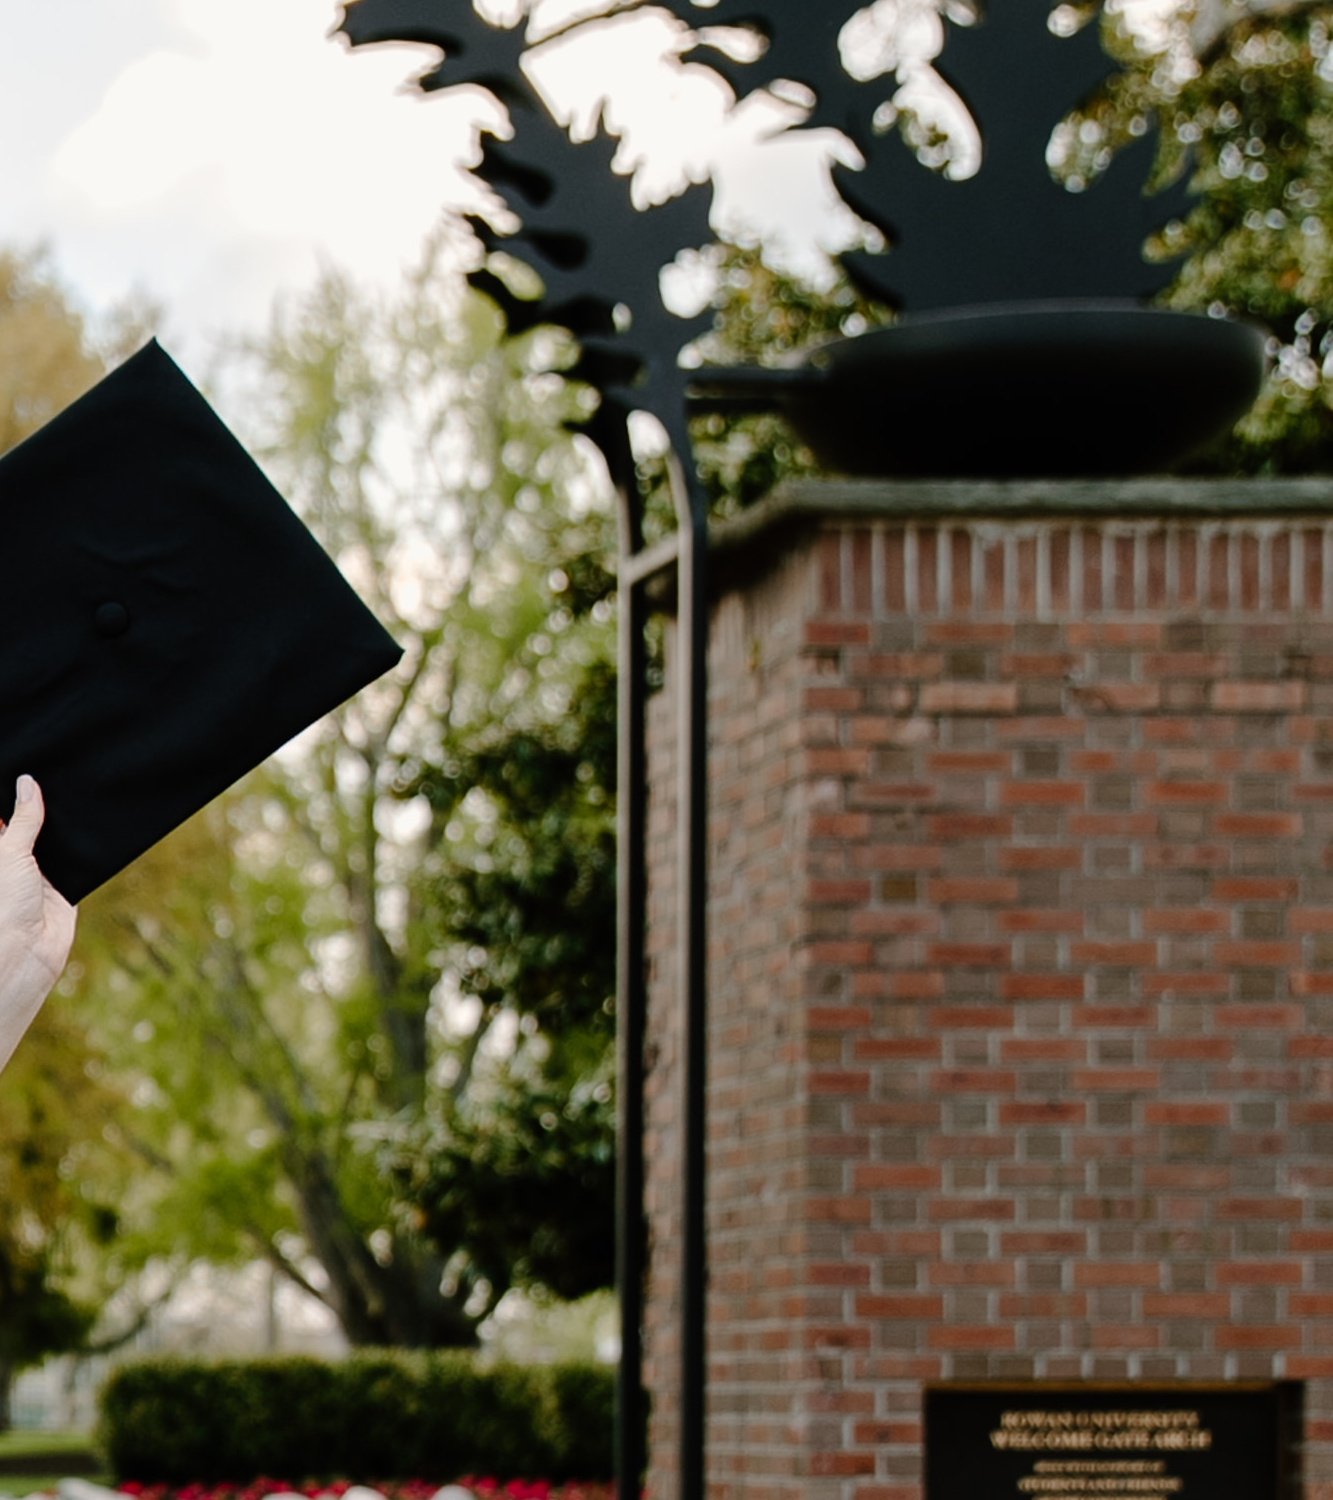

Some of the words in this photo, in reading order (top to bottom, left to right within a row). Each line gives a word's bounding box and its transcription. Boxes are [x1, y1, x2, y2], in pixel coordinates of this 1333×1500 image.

[1000, 1411, 1074, 1428] ROWAN
[1076, 1411, 1199, 1428] UNIVERSITY
[990, 1430, 1093, 1449] WELCOME
